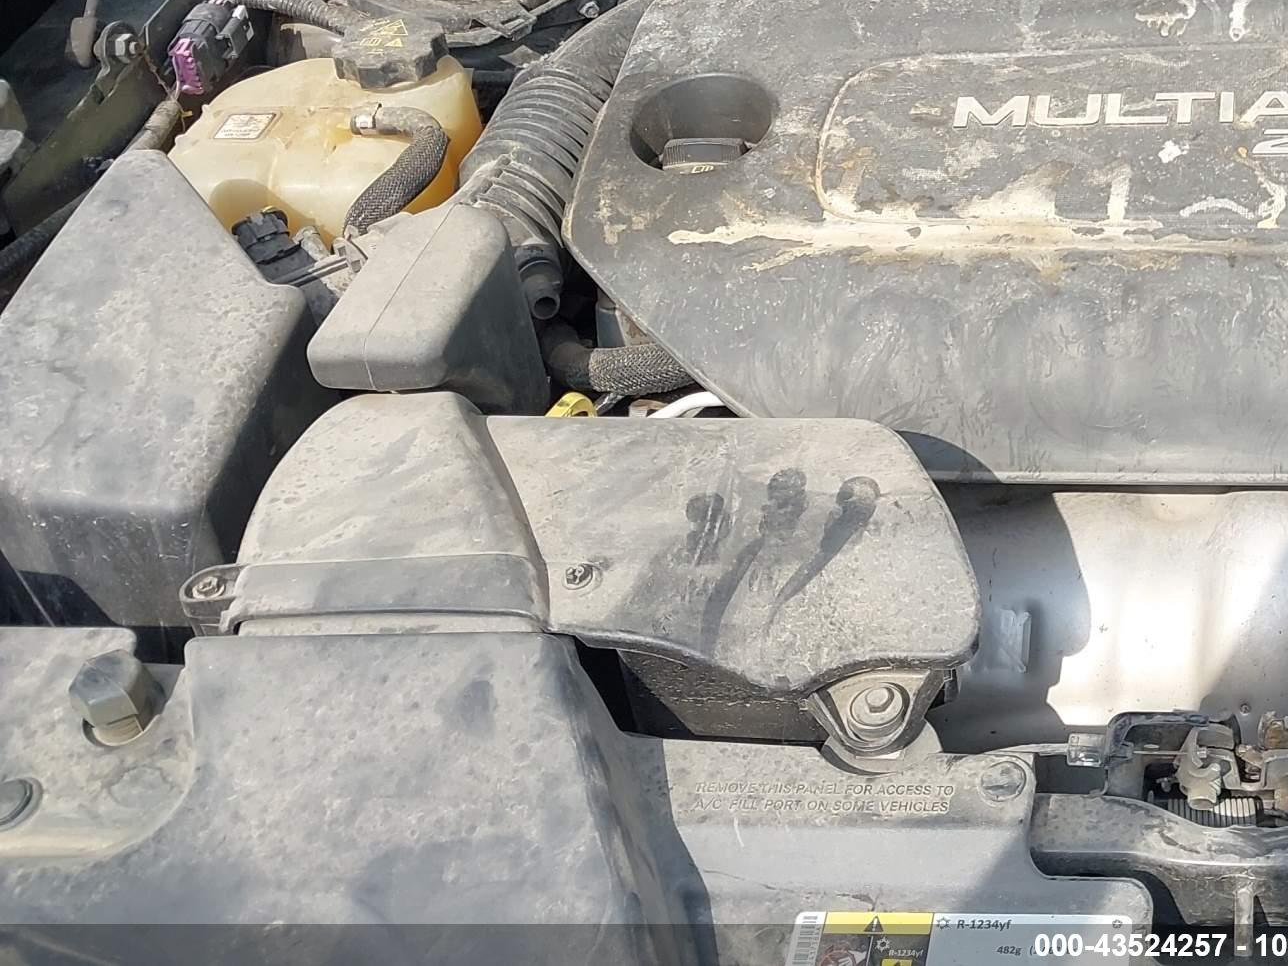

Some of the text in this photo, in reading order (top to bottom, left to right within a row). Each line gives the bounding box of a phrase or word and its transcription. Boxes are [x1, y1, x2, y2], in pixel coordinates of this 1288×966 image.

[695, 781, 954, 796] REMOVE THIS PANEL FOR ACCESS TO
[694, 797, 950, 812] A/C FILL PORT ON SOME VEHICLES
[956, 919, 1012, 931] R-1234yf
